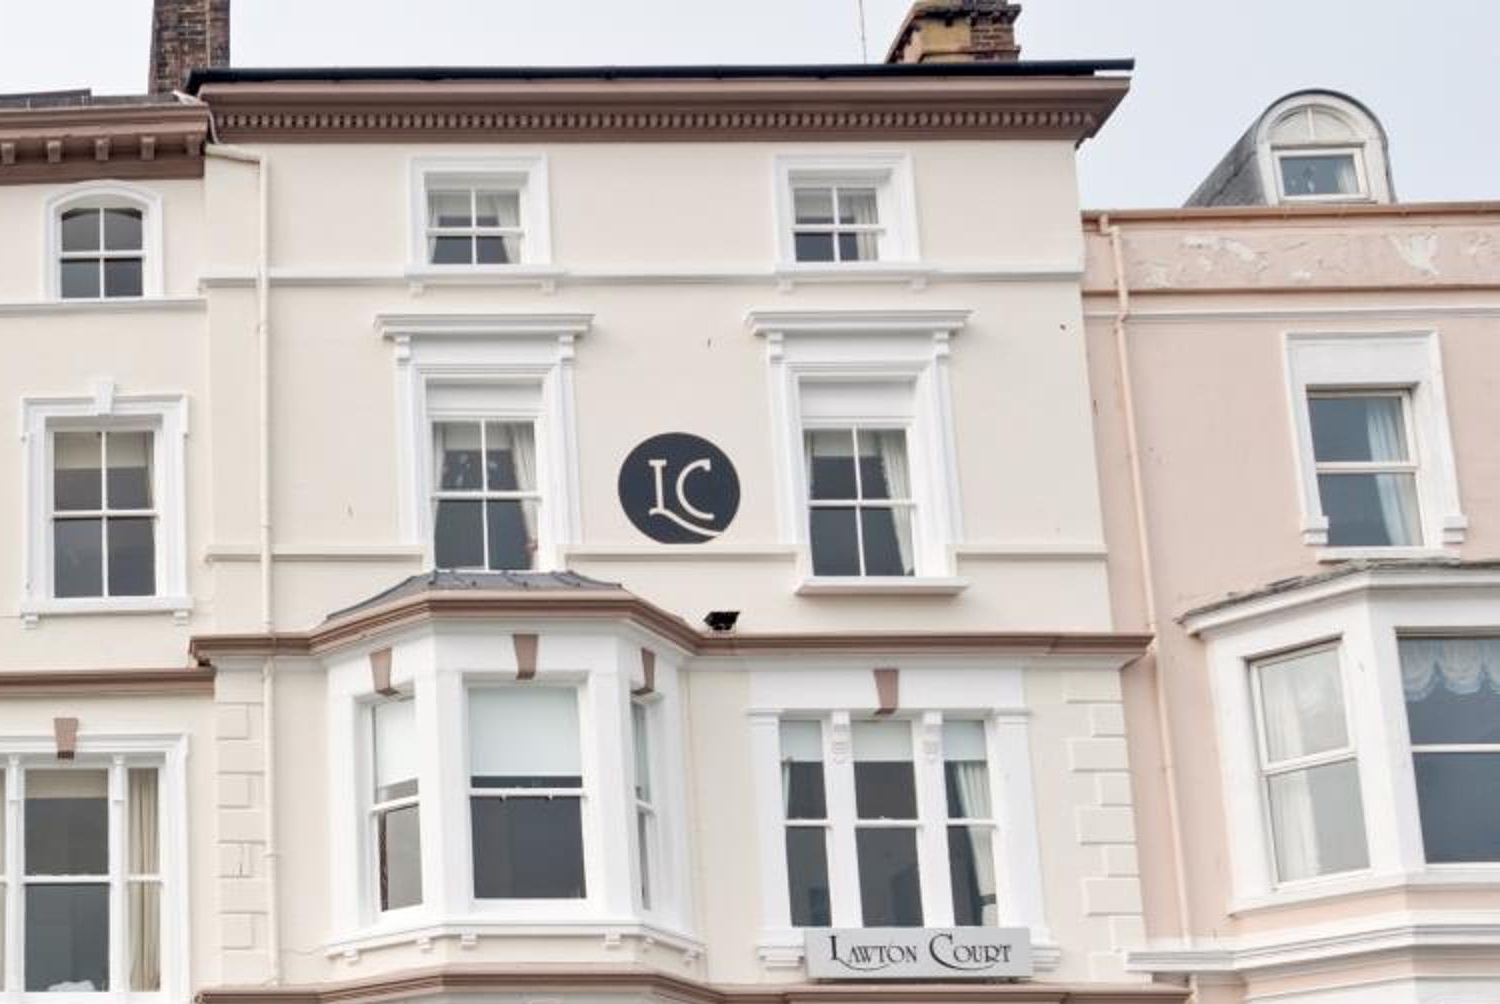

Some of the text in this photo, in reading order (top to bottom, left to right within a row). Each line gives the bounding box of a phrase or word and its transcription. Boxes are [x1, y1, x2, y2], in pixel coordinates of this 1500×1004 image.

[648, 458, 722, 537] LC
[828, 931, 1013, 972] LAWTON COURT
